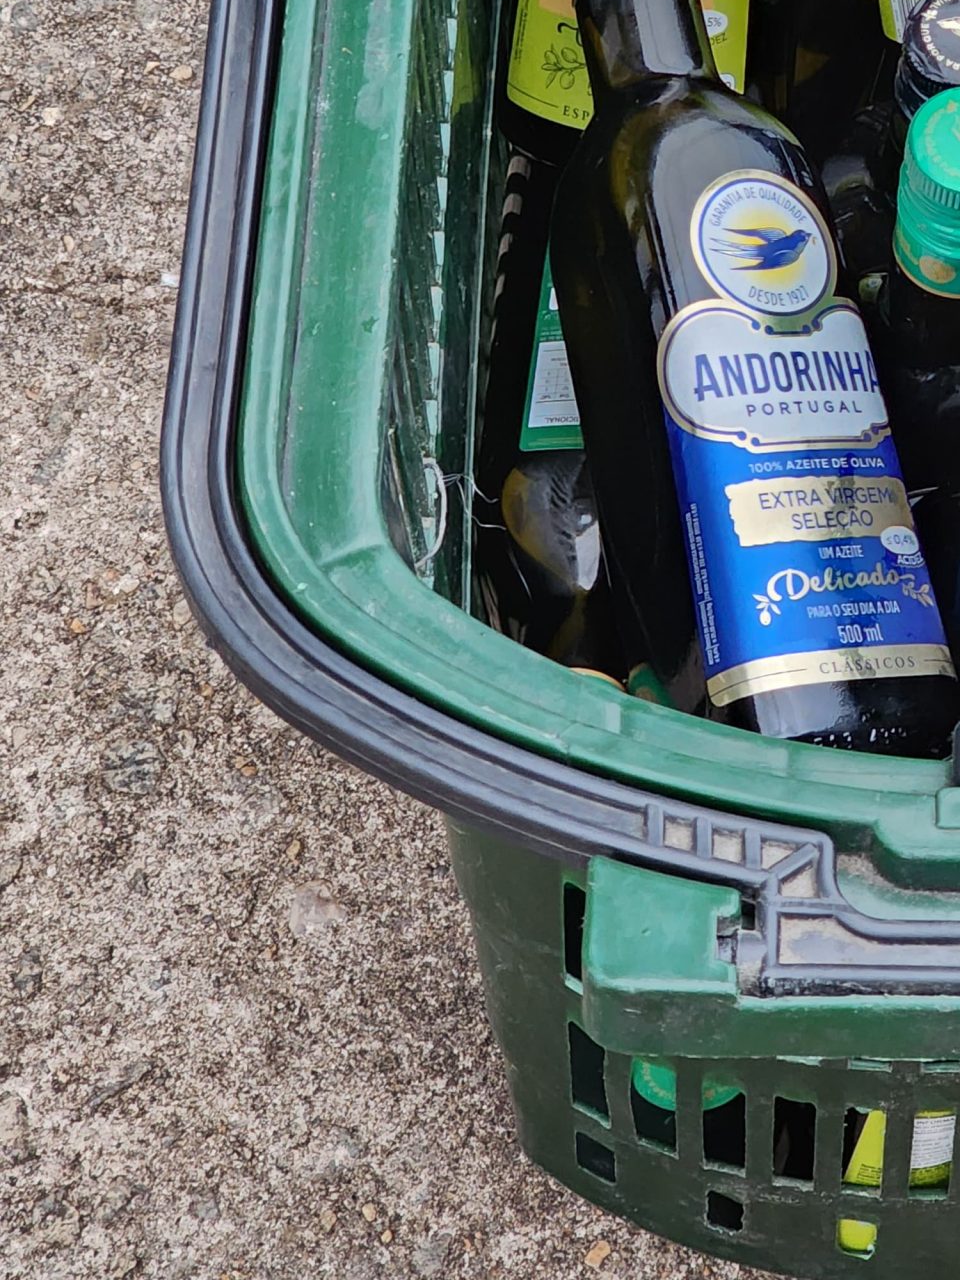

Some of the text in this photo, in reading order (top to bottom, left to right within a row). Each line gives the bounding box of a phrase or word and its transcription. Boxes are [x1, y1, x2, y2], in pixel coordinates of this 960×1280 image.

[920, 23, 933, 43] QUE
[927, 43, 945, 61] POR
[709, 187, 808, 227] GARANTIA DE QUALIDADE
[749, 285, 810, 307] DESDE 1927
[694, 349, 879, 402] ANDORINHA
[746, 400, 863, 417] PORTUGAL
[749, 457, 885, 473] 100% AZEITE DE OLIVA
[758, 487, 892, 510] EXTRA VIRGEM
[791, 504, 874, 530] SELEÇÃO
[818, 545, 864, 560] UM AZEITE
[767, 563, 915, 601] Delicado
[807, 601, 900, 619] PARA O SEU DIA A DIA
[837, 624, 884, 644] 500 ml
[819, 654, 916, 674] CLÁSSICOS
